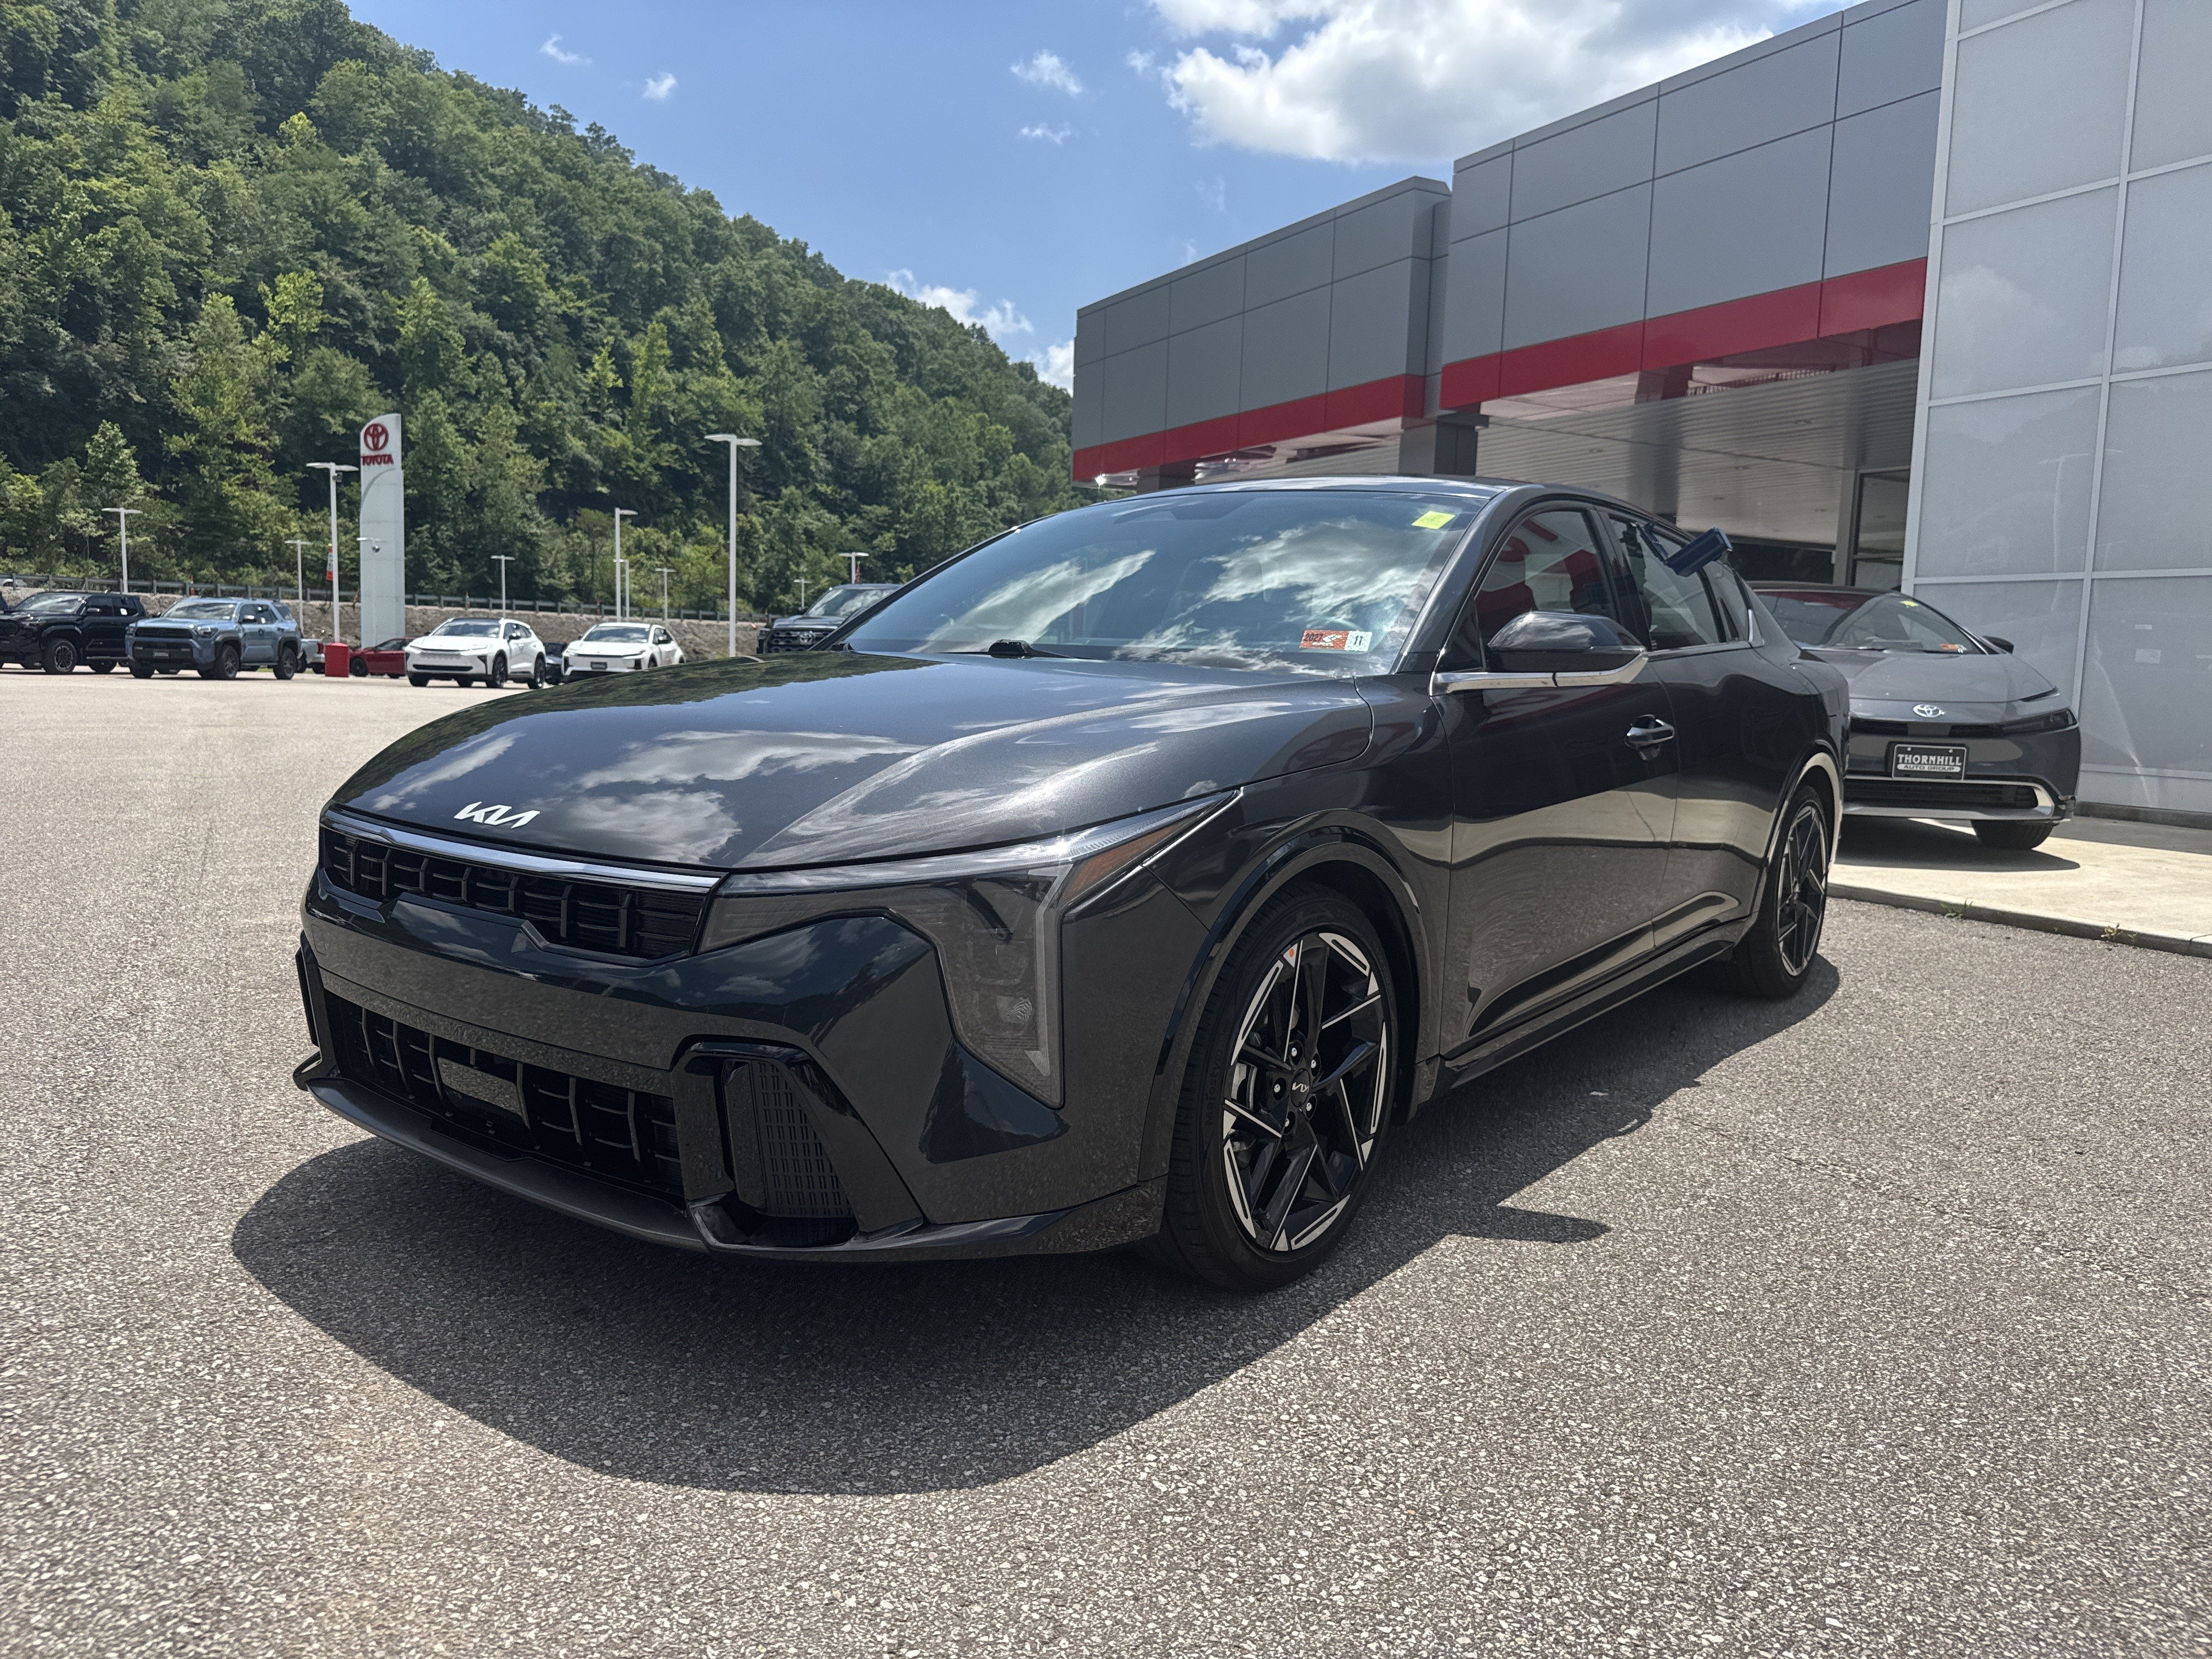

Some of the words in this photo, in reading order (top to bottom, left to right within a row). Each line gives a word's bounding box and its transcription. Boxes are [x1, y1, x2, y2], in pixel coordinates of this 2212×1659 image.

[361, 454, 394, 466] TOYOTA
[1304, 633, 1324, 642] 2027
[1354, 635, 1364, 646] 11
[1897, 754, 1962, 766] THORNHILL
[454, 801, 541, 829] KIA
